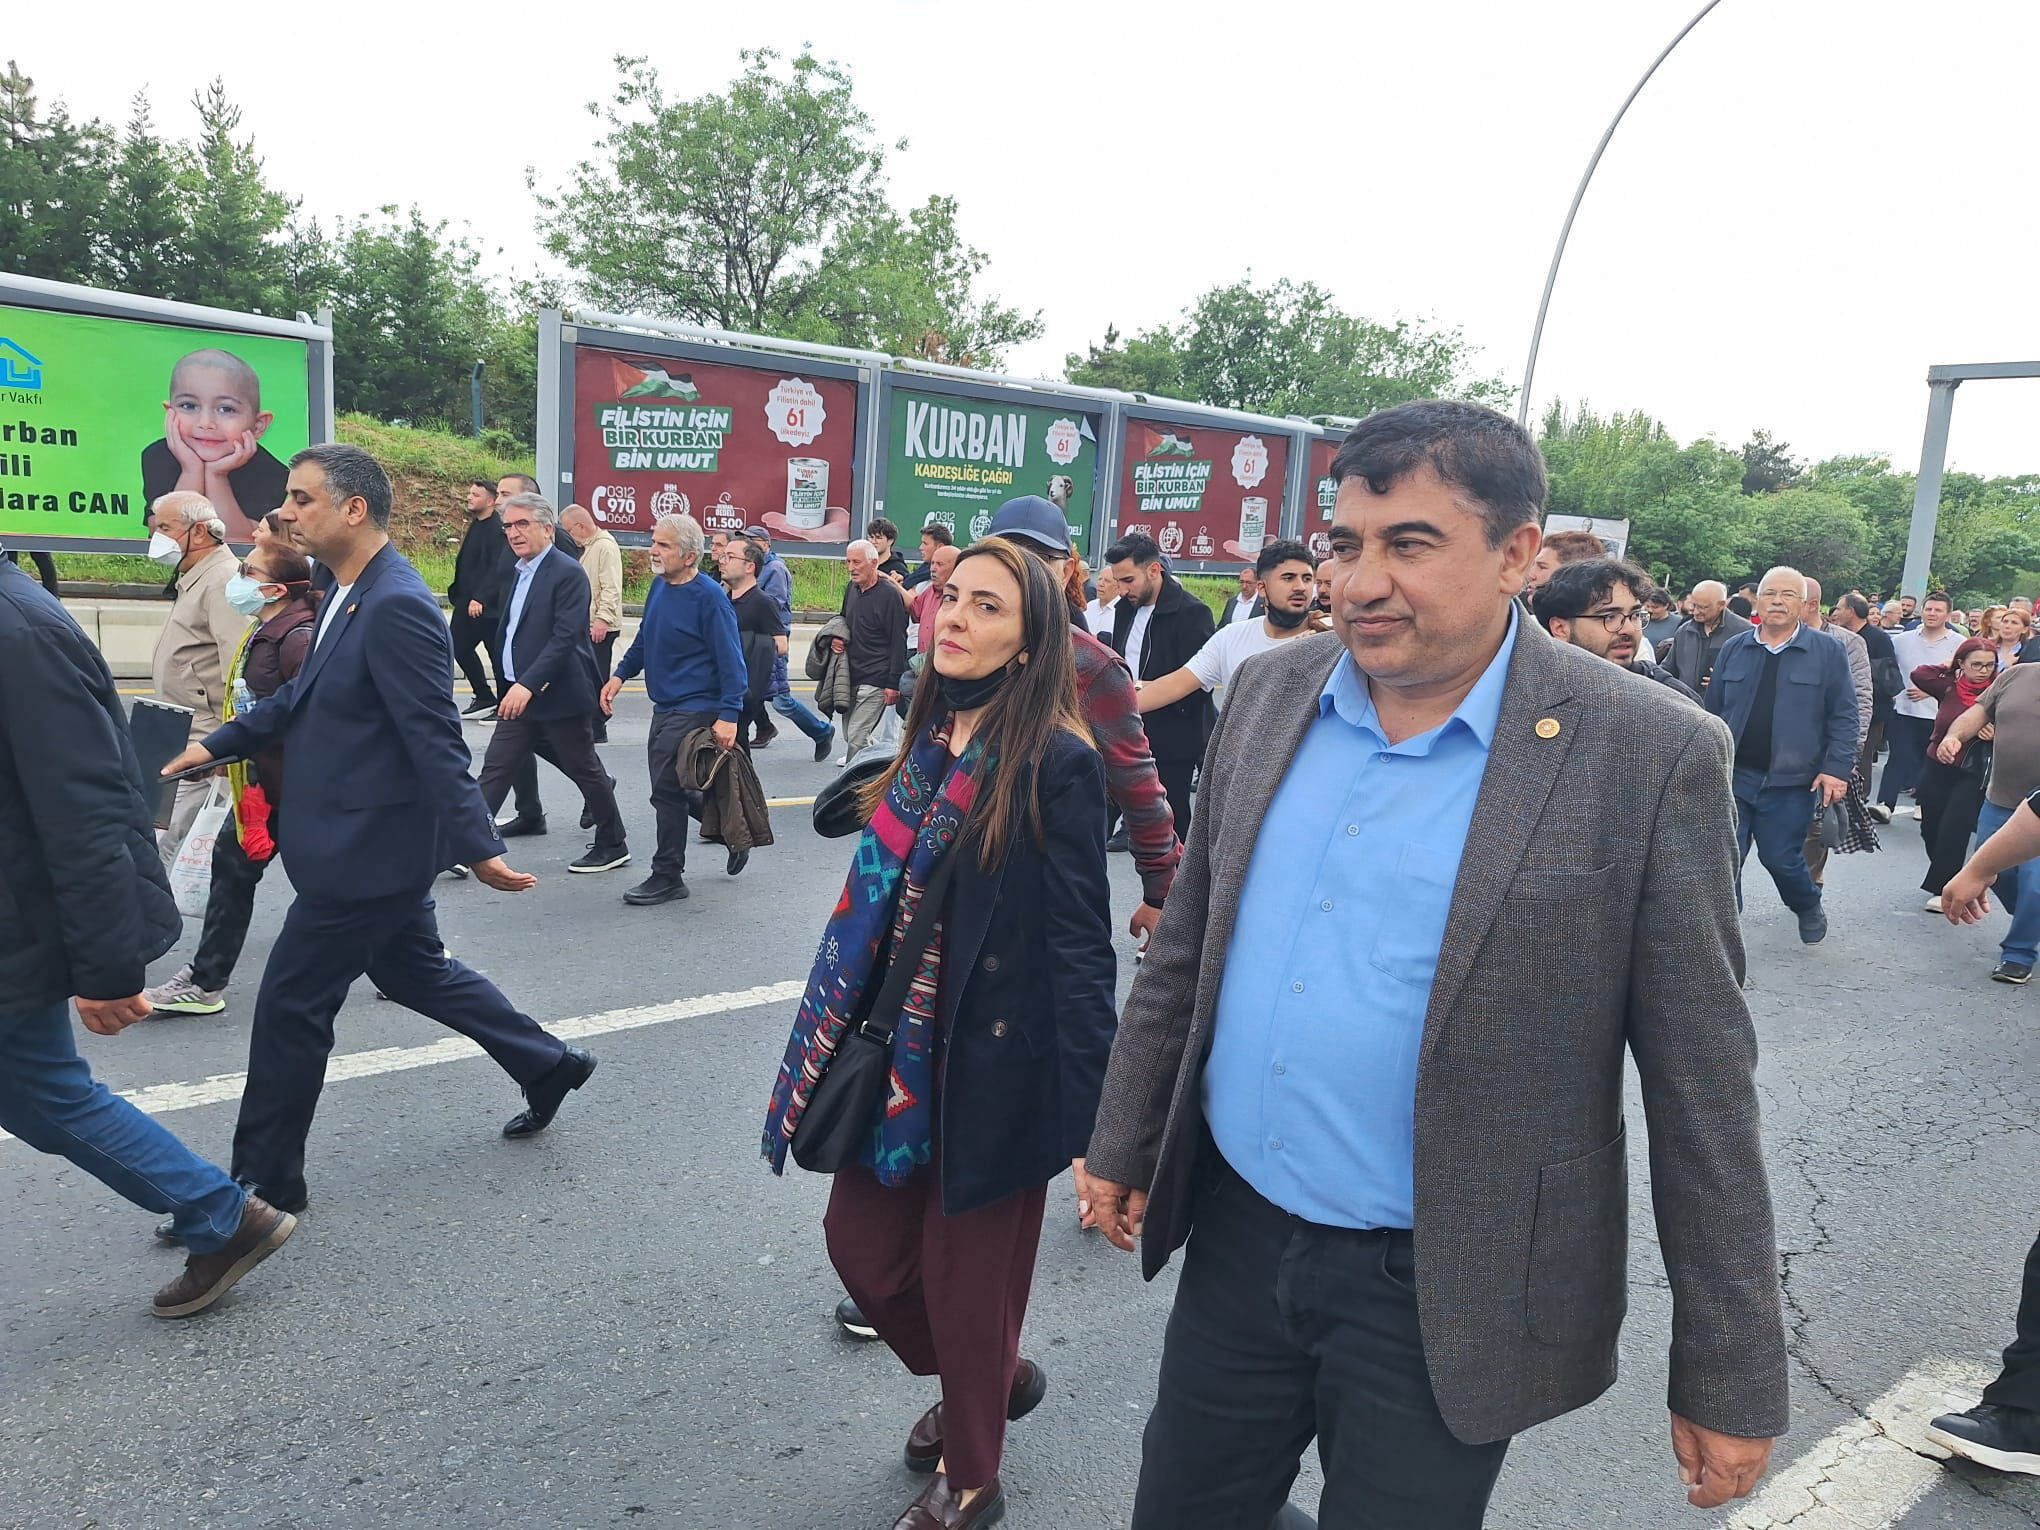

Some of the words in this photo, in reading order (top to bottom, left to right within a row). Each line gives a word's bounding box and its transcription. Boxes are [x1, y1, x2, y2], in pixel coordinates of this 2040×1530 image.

[601, 406, 684, 427] FİLİSTİN
[688, 408, 728, 430] İÇİN
[786, 407, 805, 427] 61
[3, 420, 78, 447] rban
[640, 428, 723, 448] KURBAN
[905, 400, 1027, 468] KURBAN
[1058, 439, 1069, 452] 61
[616, 448, 652, 468] BİN
[657, 453, 714, 468] UMUT
[1135, 462, 1184, 478] FİLİSTİN
[1186, 462, 1210, 479] İÇİN
[1244, 459, 1254, 473] 61
[915, 463, 979, 482] KARDEŞLİĞE
[982, 467, 1012, 485] ÇAĞRI
[607, 485, 635, 498] 0312
[1157, 480, 1205, 494] KURBAN
[68, 491, 129, 515] CAN
[608, 498, 636, 513] 970
[1141, 495, 1163, 510] BİN
[1165, 496, 1200, 509] UMUT
[607, 513, 635, 524] 0660
[706, 517, 743, 529] 11.500
[935, 511, 955, 521] 0312
[1135, 524, 1151, 534] 0312
